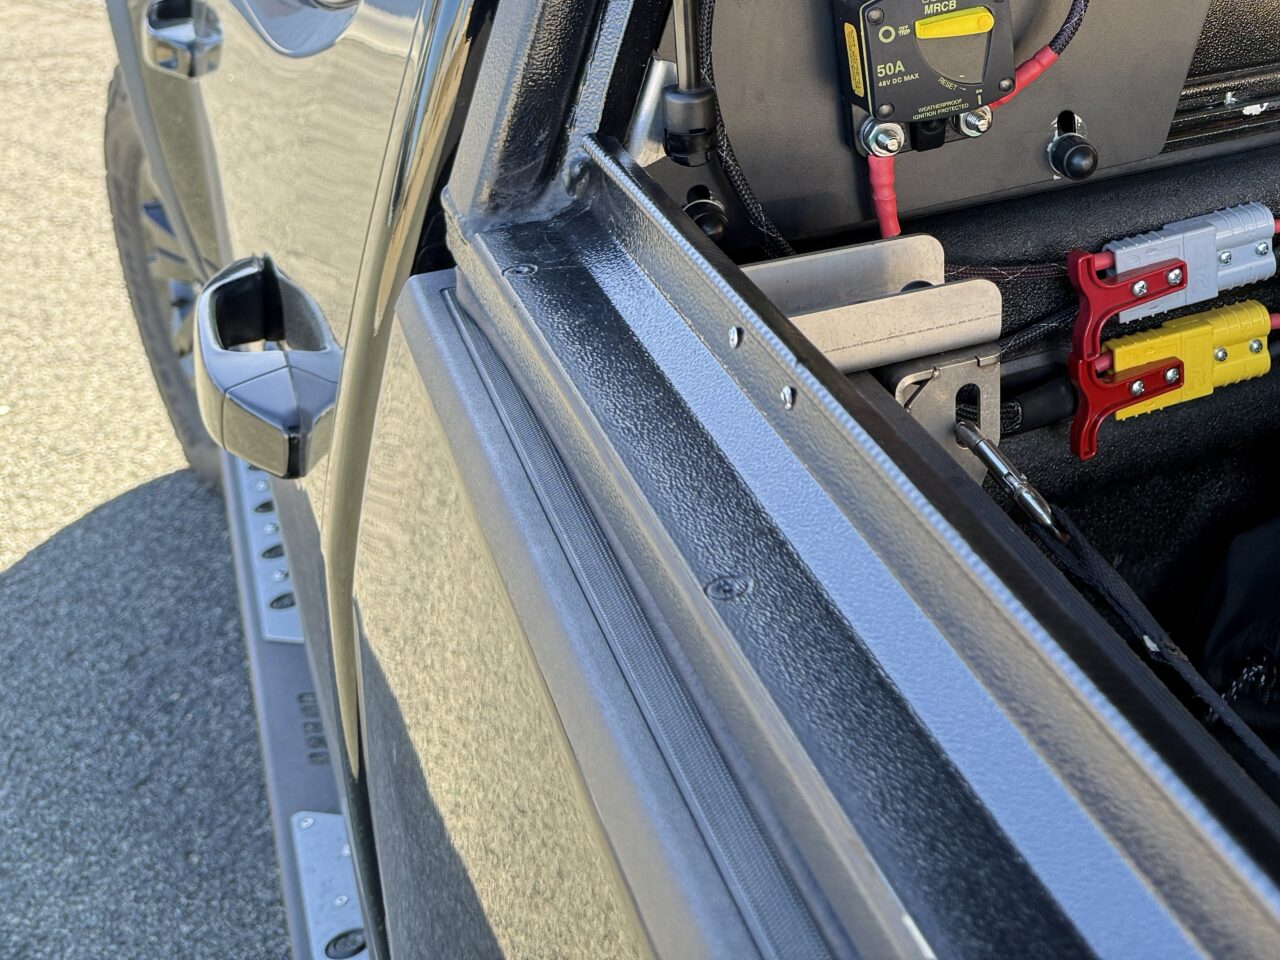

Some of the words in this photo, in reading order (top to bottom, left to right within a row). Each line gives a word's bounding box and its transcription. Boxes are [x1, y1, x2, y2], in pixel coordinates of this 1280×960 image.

[924, 0, 957, 15] MRCB
[877, 60, 905, 77] 50A
[903, 73, 920, 82] MAX
[938, 76, 958, 90] RESET
[912, 109, 937, 120] IGNITION
[937, 102, 970, 115] PROTECTED
[918, 98, 962, 113] WEATHERPROOF
